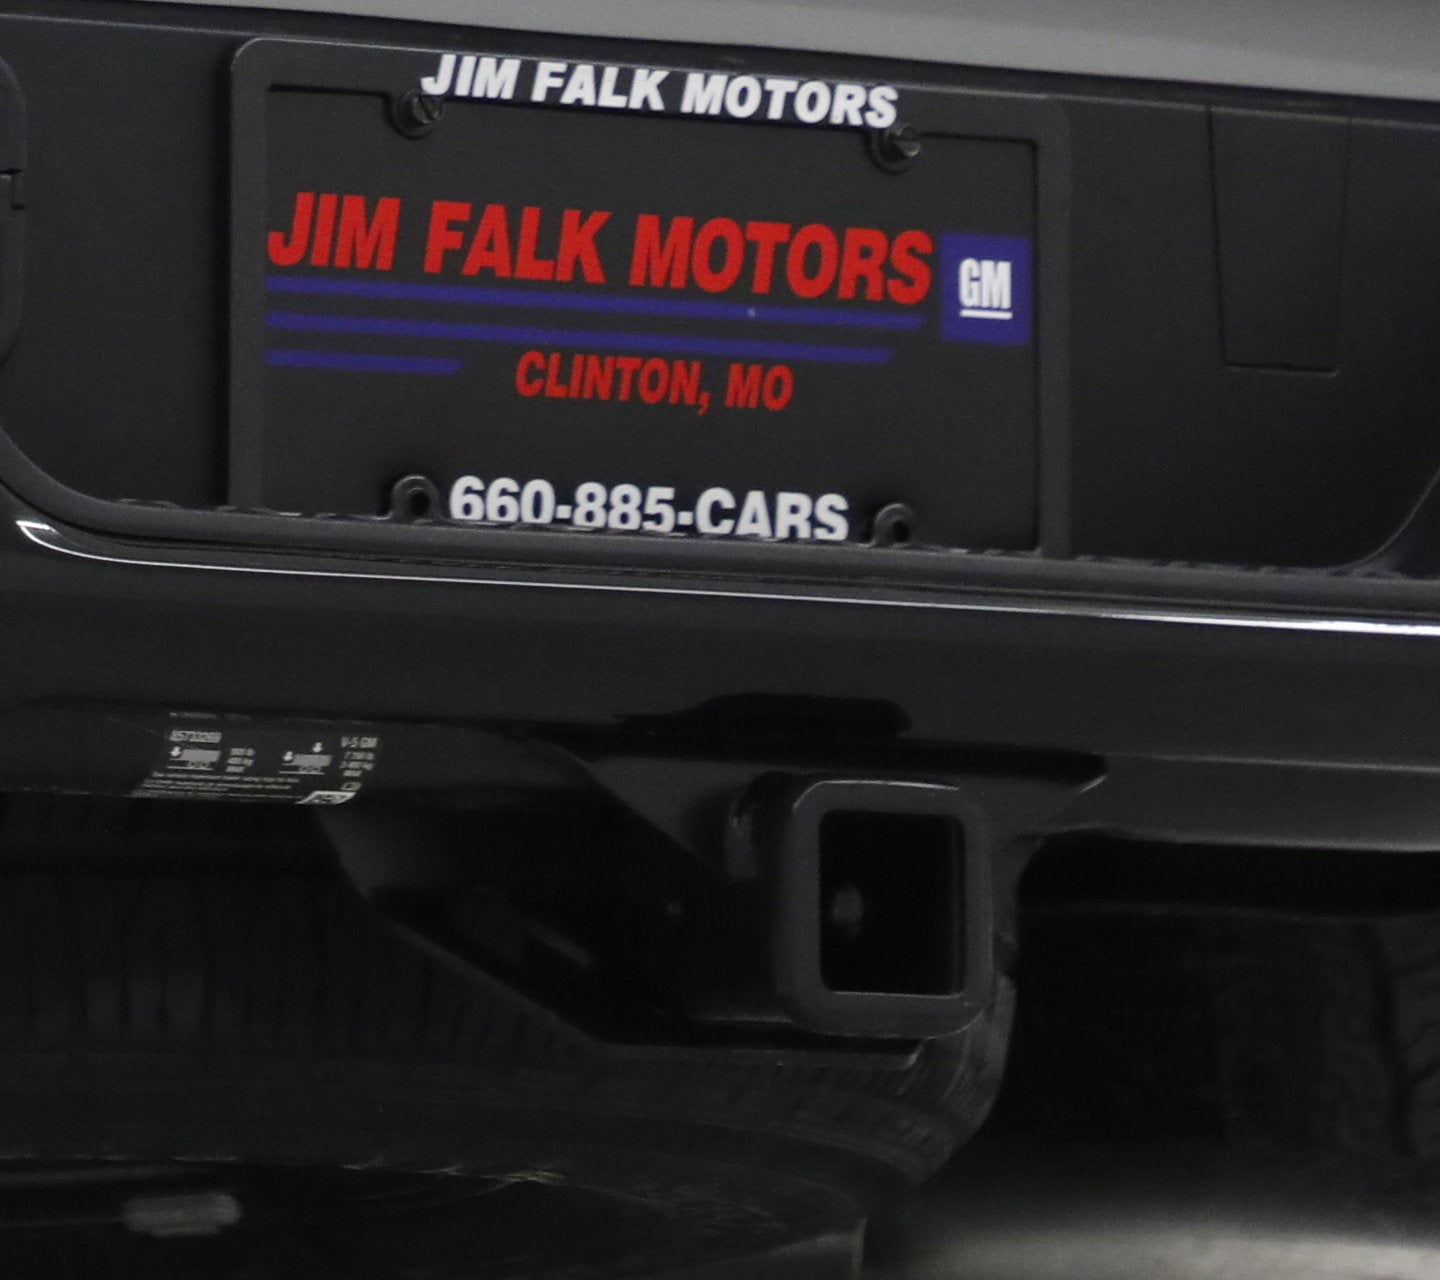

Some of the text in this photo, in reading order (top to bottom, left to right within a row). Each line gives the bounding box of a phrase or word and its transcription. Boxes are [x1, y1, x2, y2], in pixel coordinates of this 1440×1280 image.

[421, 52, 898, 130] JIM FALK MOTORS
[267, 191, 933, 305] JIM FALK MOTORS
[958, 258, 1012, 310] GM
[515, 350, 793, 416] CLINTON, MO
[449, 474, 850, 542] 660-885-CARS
